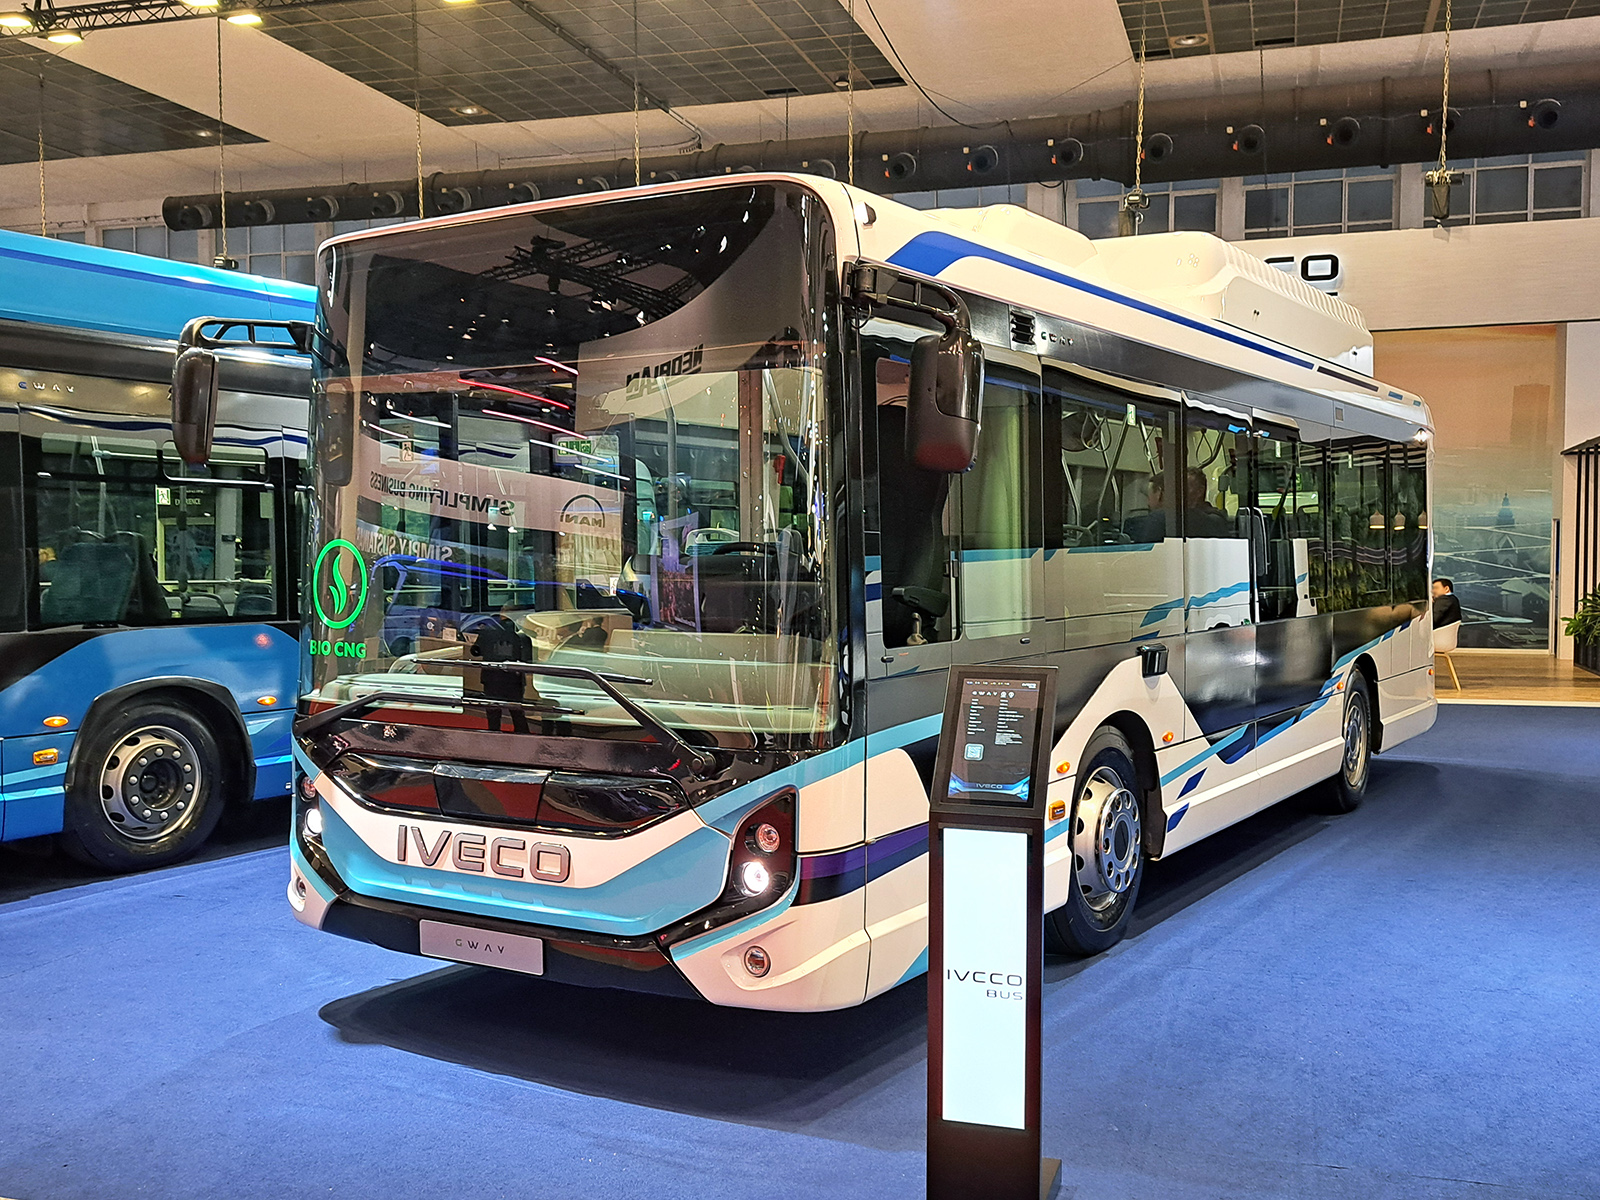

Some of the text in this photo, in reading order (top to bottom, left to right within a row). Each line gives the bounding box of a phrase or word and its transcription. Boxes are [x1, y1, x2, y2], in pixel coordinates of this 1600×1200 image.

[310, 640, 367, 659] BIO CNG
[397, 825, 571, 883] IVECO
[986, 989, 1023, 1001] BUS
